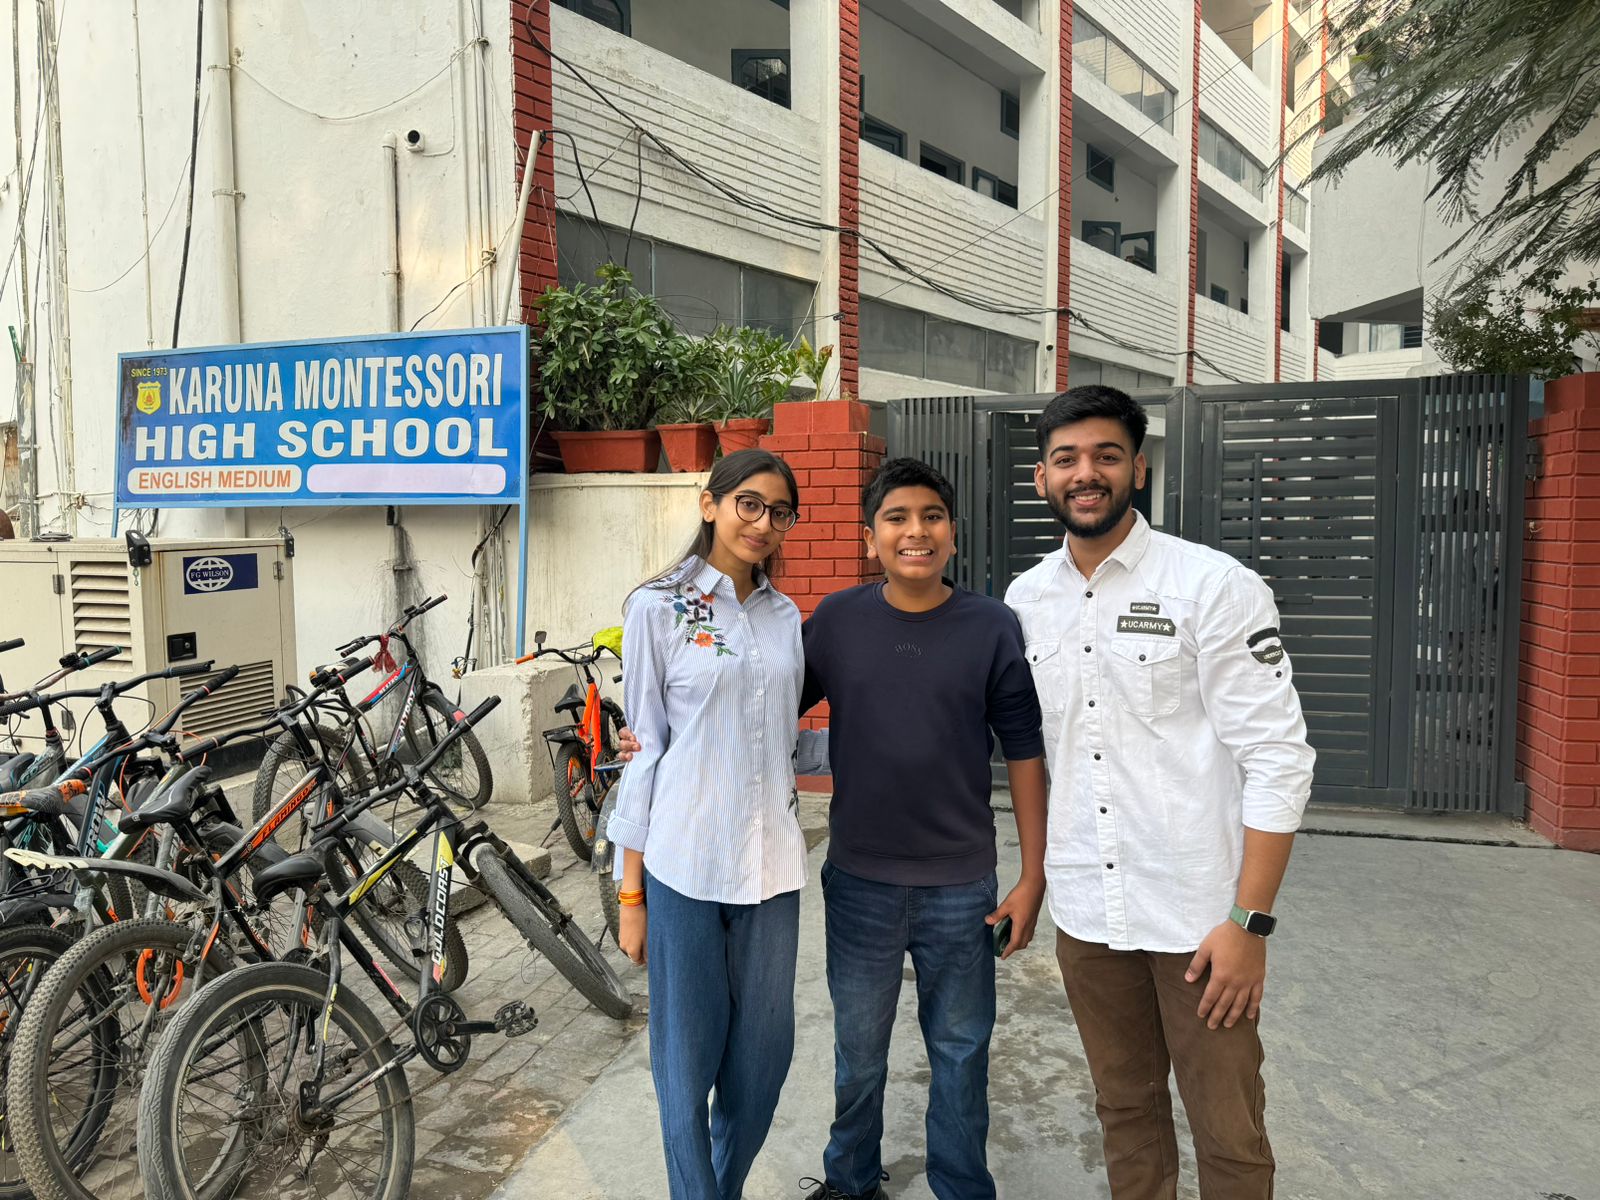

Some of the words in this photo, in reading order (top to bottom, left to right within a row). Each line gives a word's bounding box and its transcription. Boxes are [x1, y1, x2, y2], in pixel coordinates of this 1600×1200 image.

[131, 367, 151, 377] SINCE
[153, 367, 168, 377] 1973
[169, 362, 284, 415] KARUNA
[294, 353, 502, 411] MONTESSORI
[135, 422, 256, 461] HIGH
[278, 417, 508, 458] SCHOOL
[138, 470, 211, 489] ENGLISH
[217, 469, 291, 488] MEDIUM
[191, 571, 201, 579] FG
[202, 569, 229, 578] WILSON
[1128, 620, 1163, 631] UCARMY
[432, 856, 449, 966] GOLDCOAST
